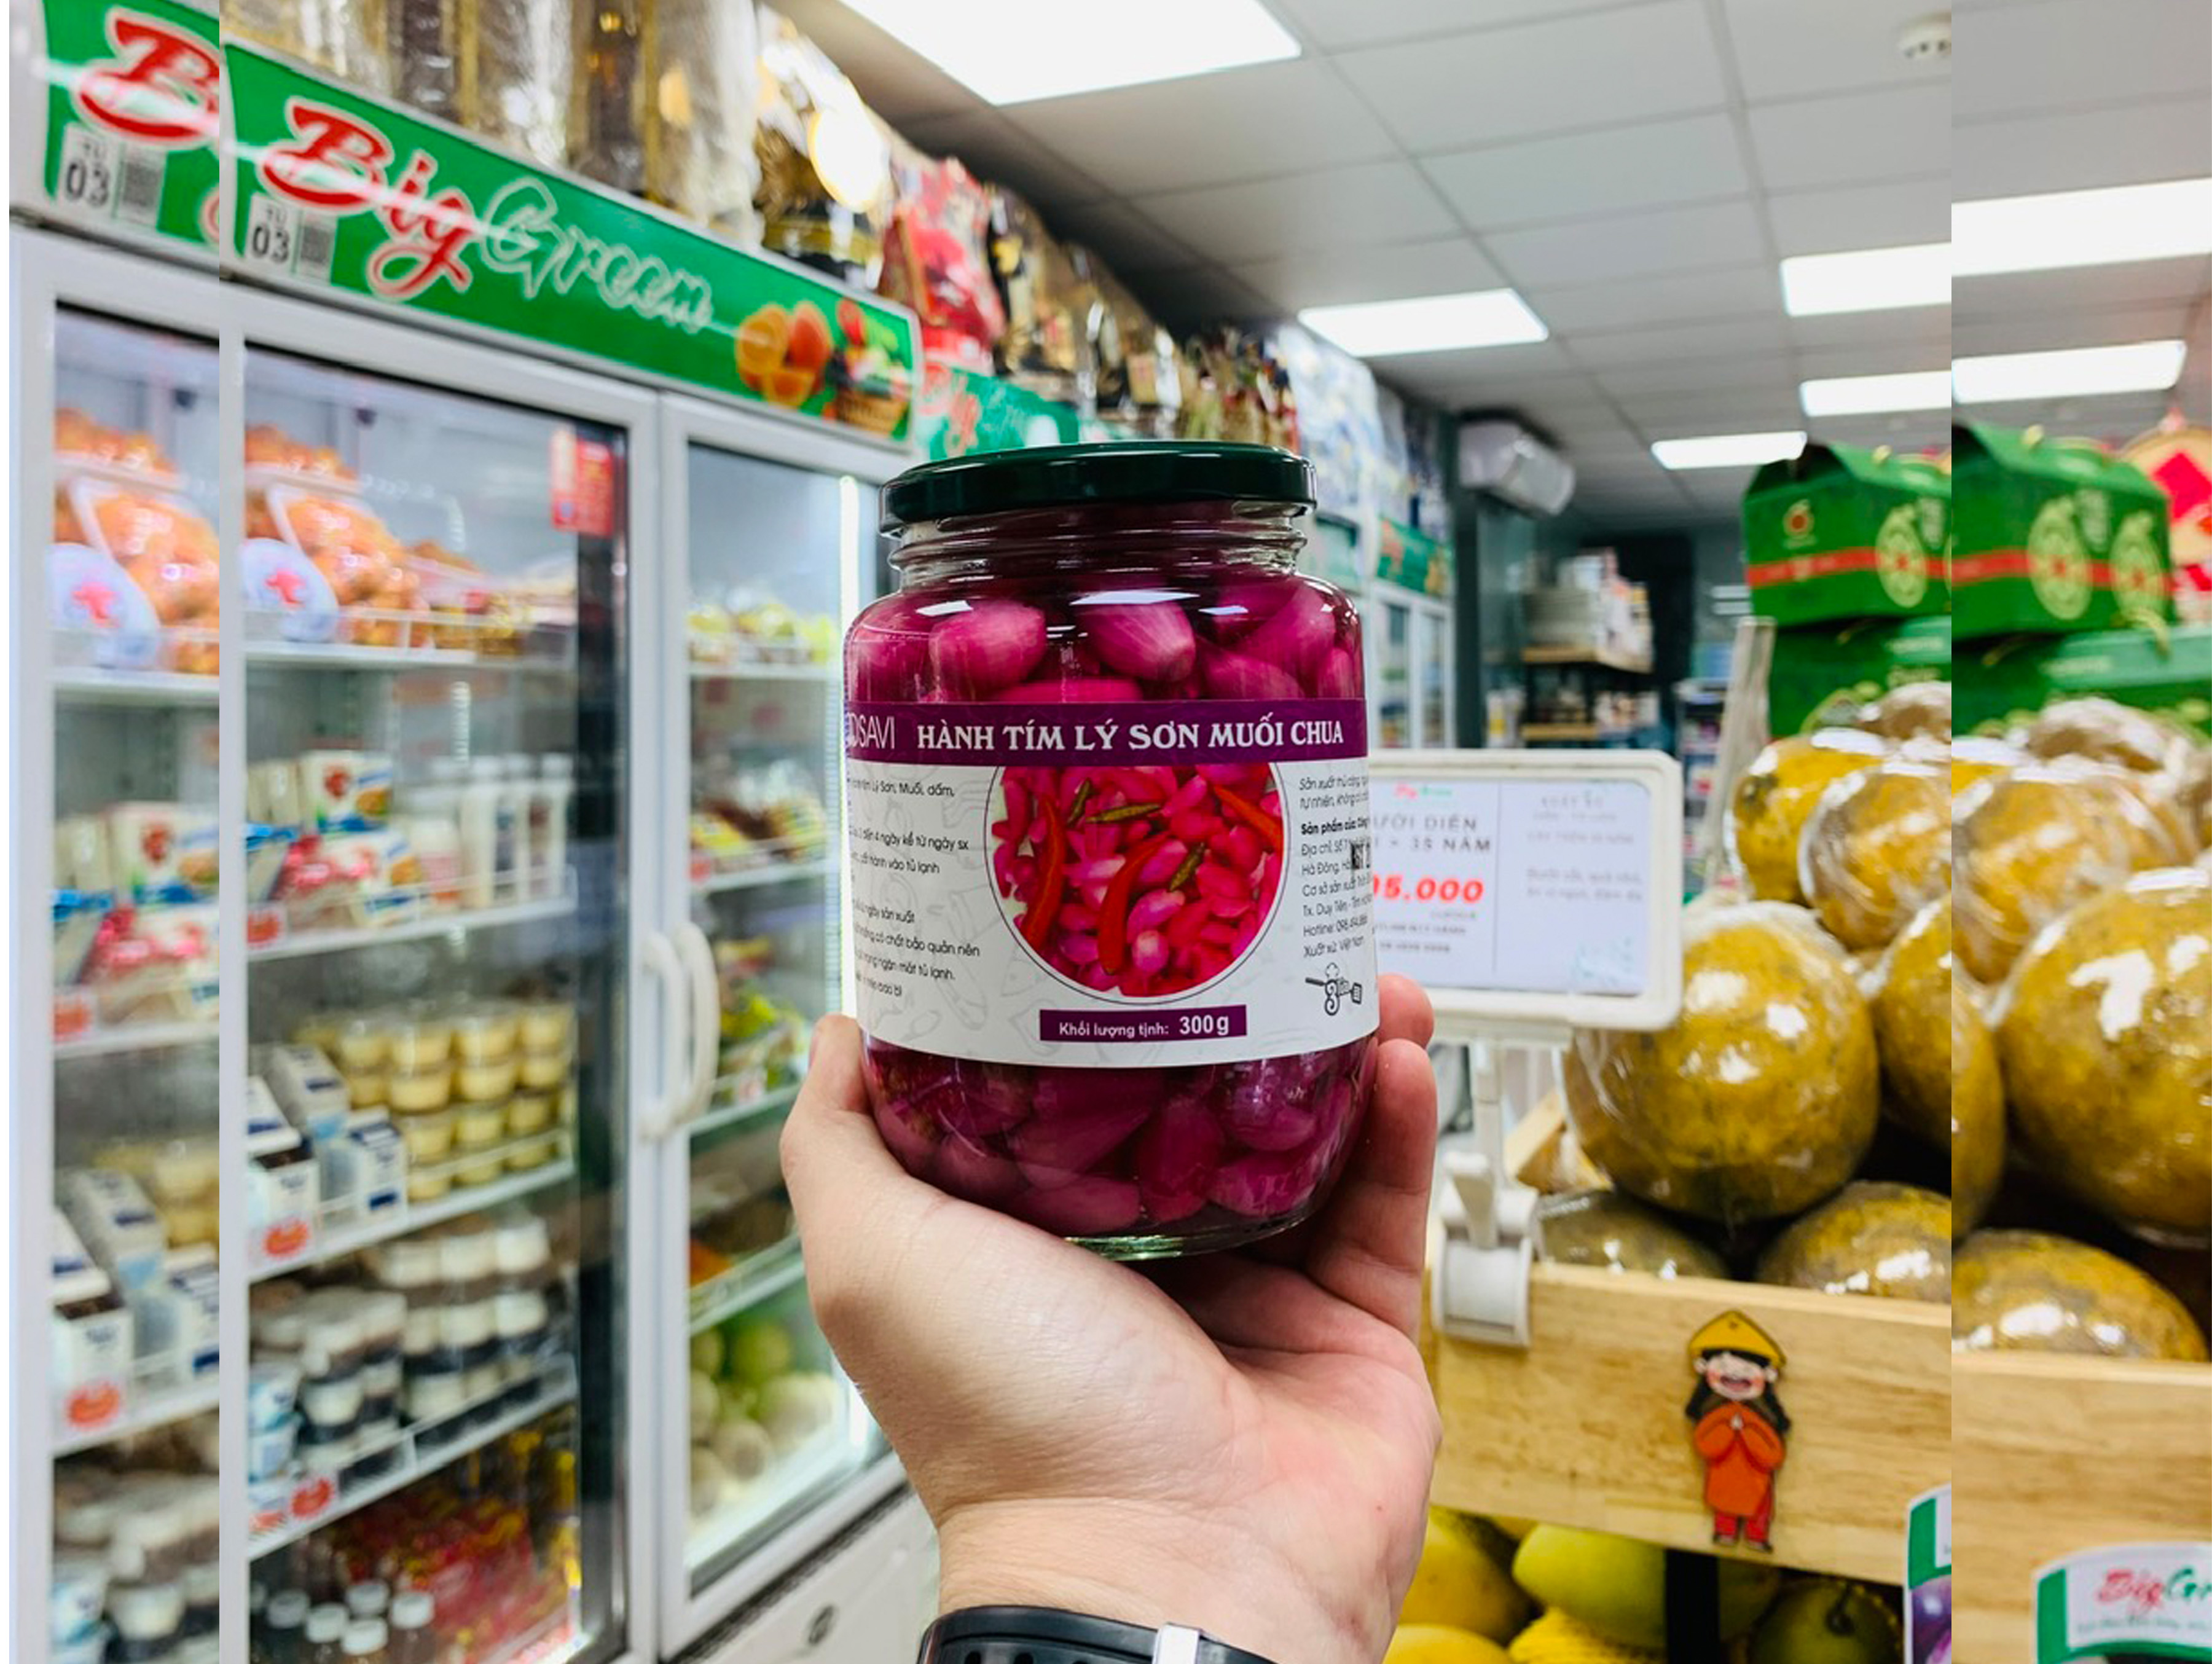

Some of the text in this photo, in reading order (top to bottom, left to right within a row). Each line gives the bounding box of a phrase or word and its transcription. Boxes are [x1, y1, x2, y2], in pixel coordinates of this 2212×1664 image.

[66, 161, 109, 208] 03
[252, 225, 291, 264] 03
[917, 712, 1344, 750] HÀNH TÍM LÝ SƠN MUỐI CHUA
[928, 782, 955, 798] dấm,
[1301, 821, 1319, 835] Sản
[928, 836, 955, 852] ngày
[958, 839, 969, 850] sx
[918, 860, 940, 874] lạnh
[906, 936, 925, 951] bảo
[927, 940, 955, 955] quản
[957, 943, 981, 957] nên
[1059, 1021, 1090, 1036] Khối
[1094, 1022, 1135, 1039] lượng
[1138, 1022, 1169, 1038] tịnh:
